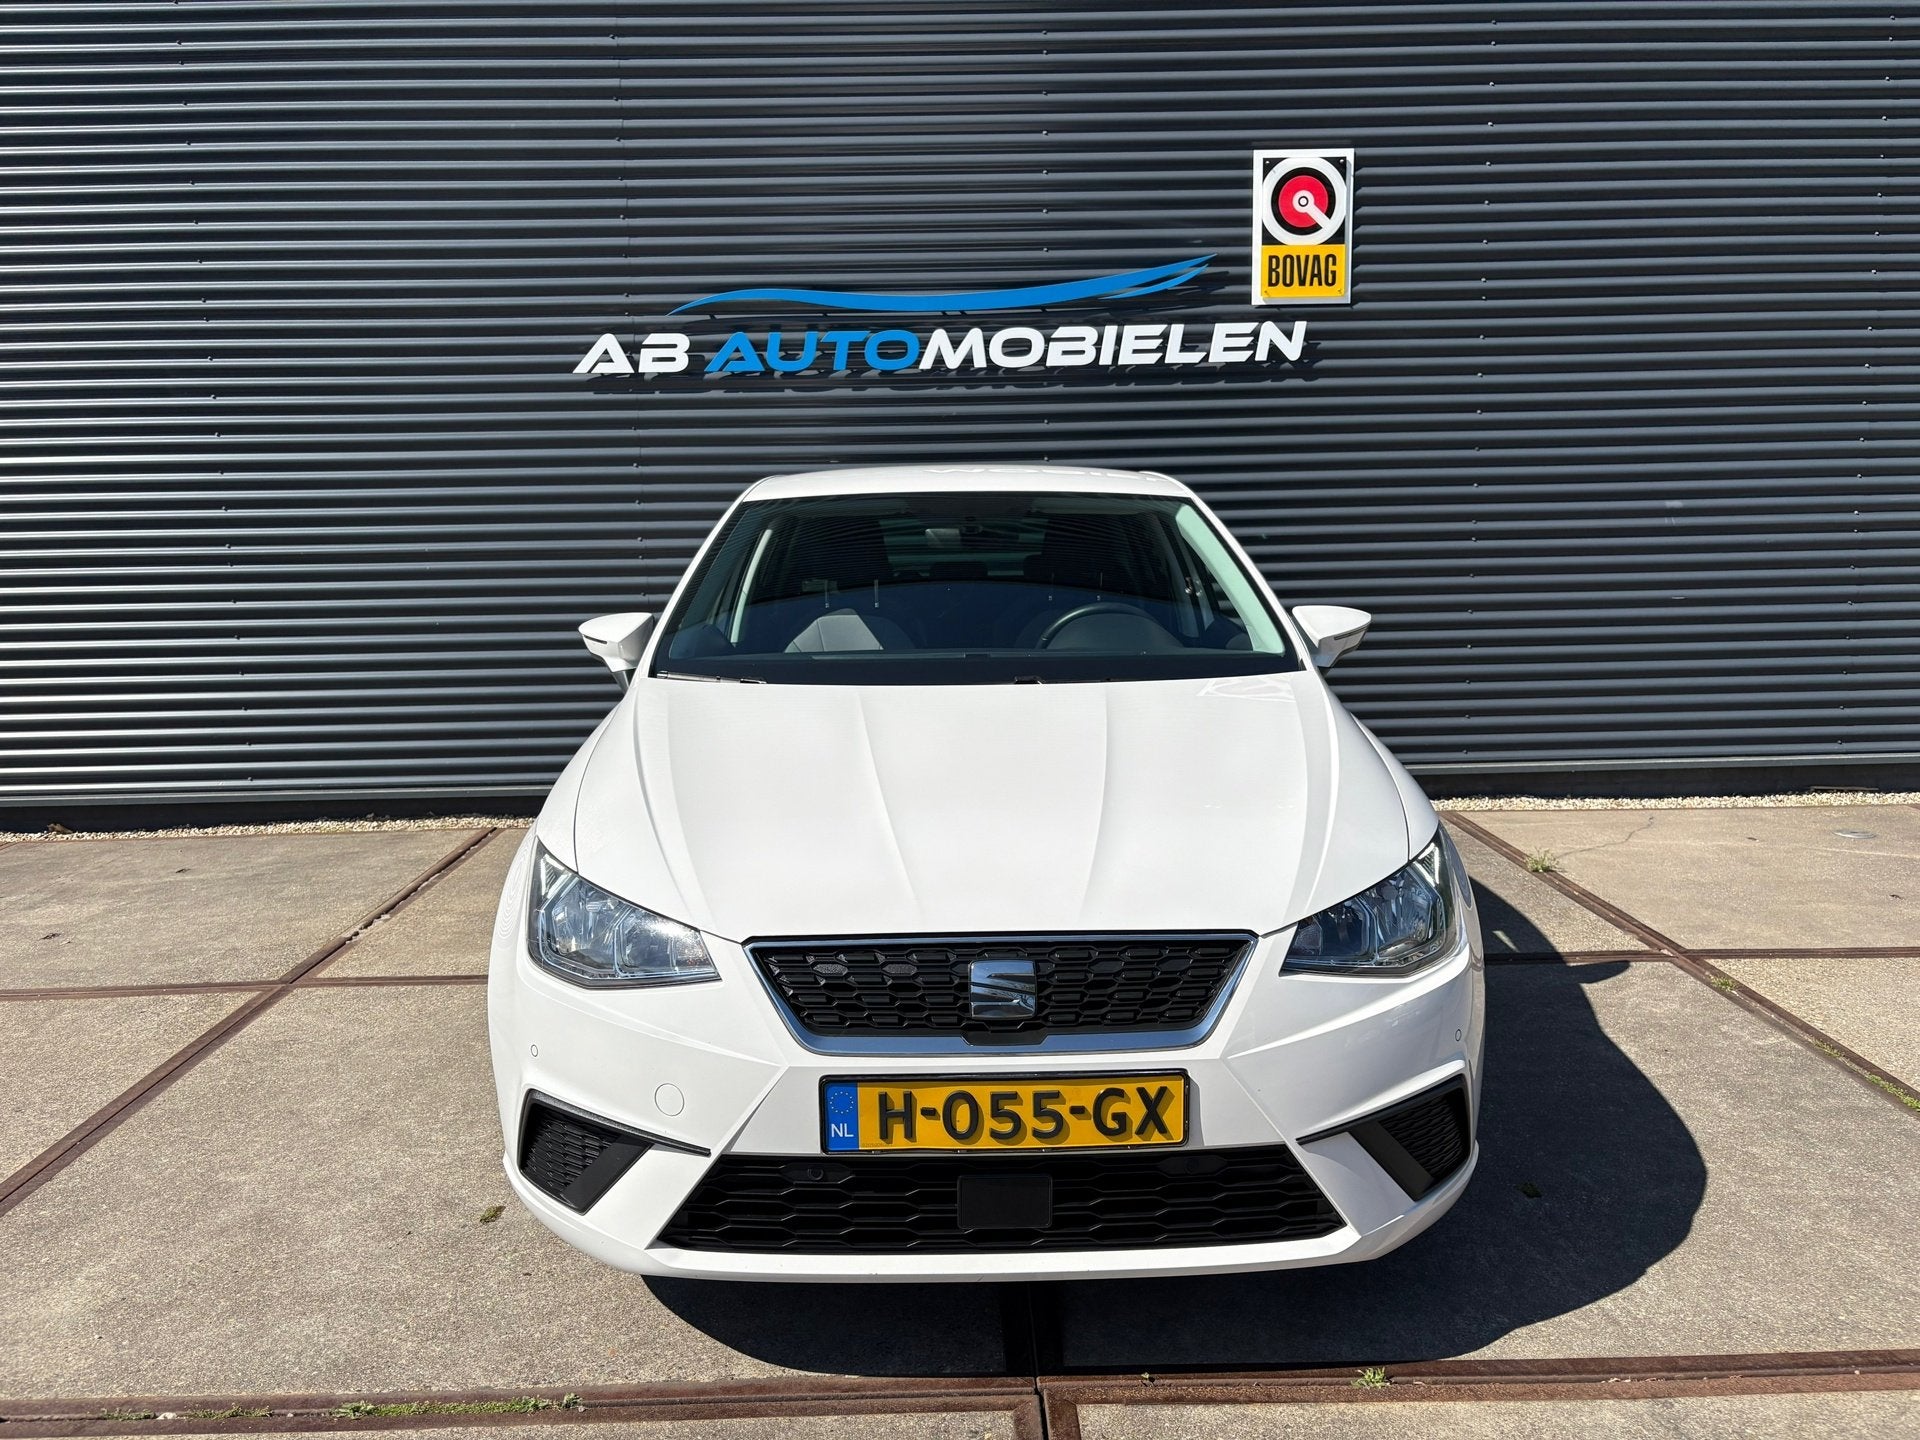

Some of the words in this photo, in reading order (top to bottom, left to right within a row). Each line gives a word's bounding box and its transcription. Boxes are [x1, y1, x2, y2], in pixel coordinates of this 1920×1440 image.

[1267, 253, 1337, 288] BOVAG
[572, 332, 691, 374] AB
[703, 320, 1308, 374] AUTOMOBIELEN
[830, 1122, 854, 1138] NL
[878, 1086, 1168, 1141] H-055-GX
